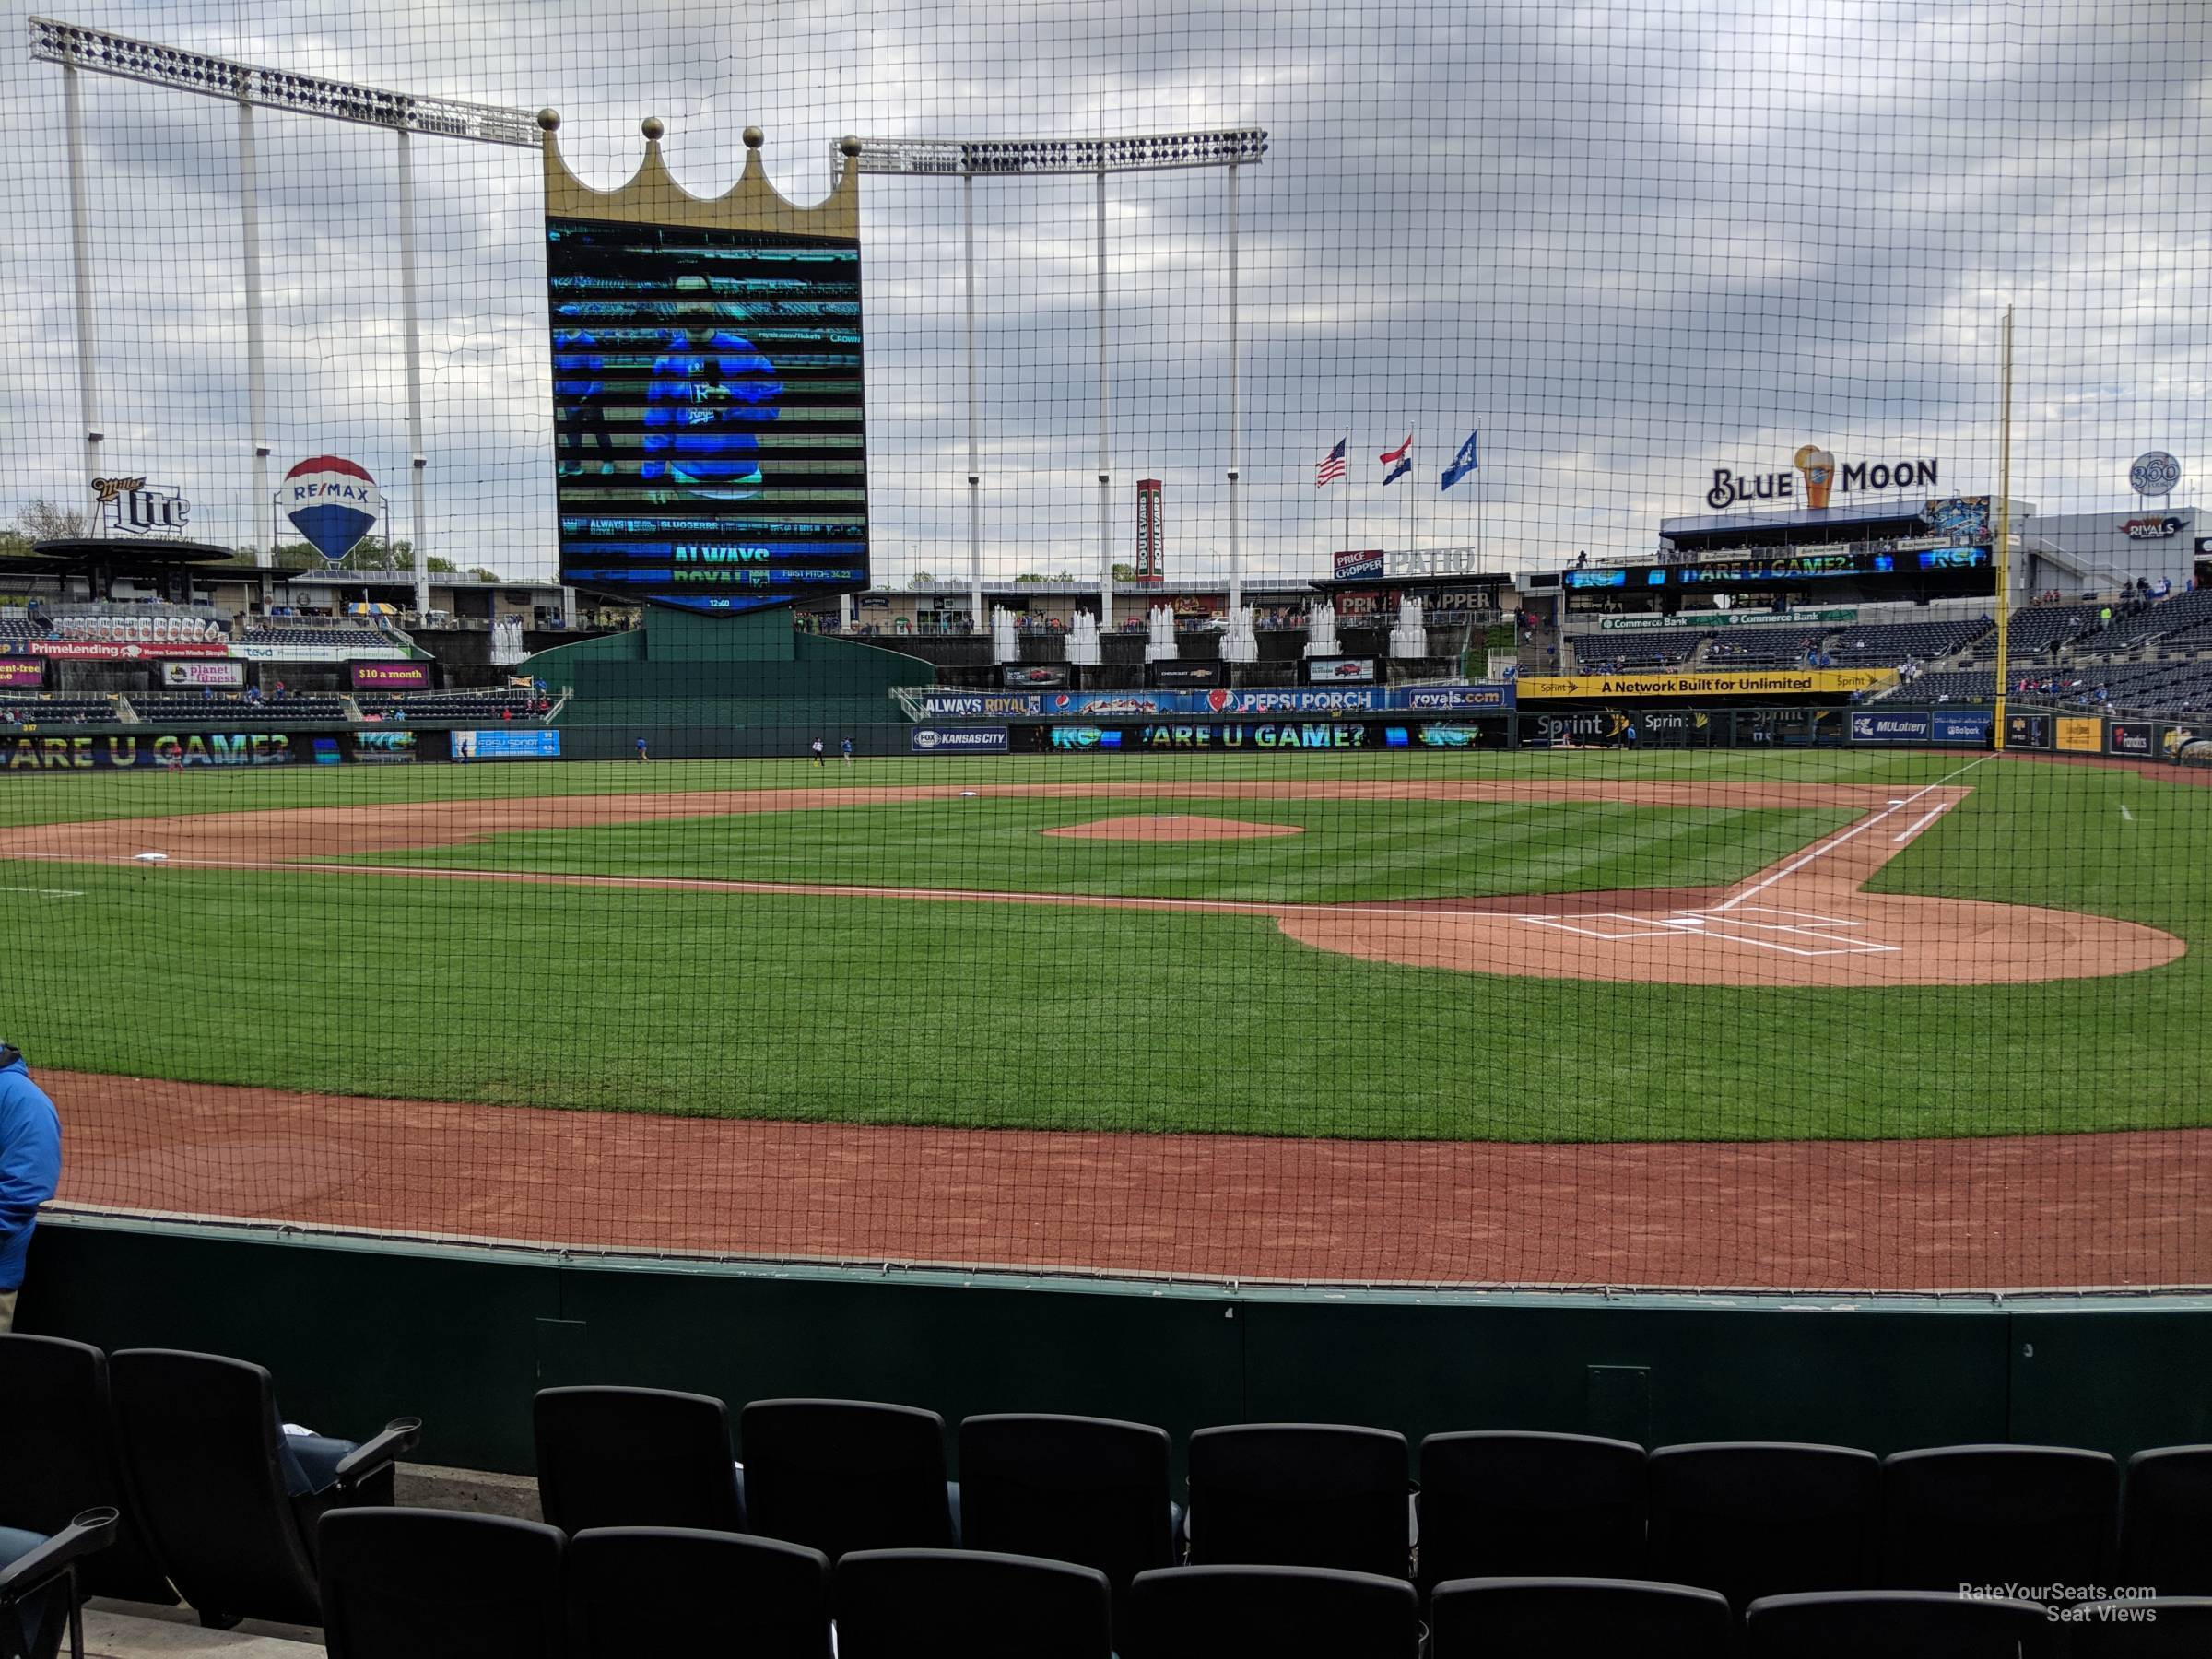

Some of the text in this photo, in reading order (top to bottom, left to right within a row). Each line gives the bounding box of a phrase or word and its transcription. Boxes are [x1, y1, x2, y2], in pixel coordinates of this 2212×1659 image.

[2131, 460, 2176, 488] 360
[93, 477, 145, 500] Miller
[294, 482, 367, 503] RE/MAX
[1708, 460, 1936, 508] BLUE MOON
[114, 490, 191, 534] Lite
[2131, 524, 2174, 536] RIVALS
[1336, 552, 1366, 567] PRICE
[1390, 547, 1476, 573] PATIO
[1336, 559, 1382, 579] CHOPPER
[1700, 562, 1742, 581] ARE
[1749, 560, 1763, 578] U
[1614, 617, 1688, 629] Commerce Bank
[1740, 611, 1819, 624] Commerce Bank
[32, 643, 119, 657] PrimeLending
[246, 647, 273, 657] teva
[190, 665, 228, 677] planet
[196, 674, 237, 682] fitness
[359, 670, 378, 679] $10
[388, 670, 422, 679] month
[1541, 675, 1865, 693] Sprint A Network Built for Unlimited Sprint
[925, 699, 1028, 713] ALWAYS ROYAL
[1244, 692, 1371, 711] PEPSI PORCH
[1414, 690, 1500, 708] royals.com
[1537, 714, 1603, 737] Sprint
[921, 734, 935, 742] FOX
[942, 734, 982, 744] KANSAS
[982, 734, 1006, 744] CITY
[1152, 725, 1211, 747] ARE
[1222, 724, 1243, 747] U
[1255, 724, 1366, 747] GAME?
[10, 735, 289, 768] ARE U GAME?
